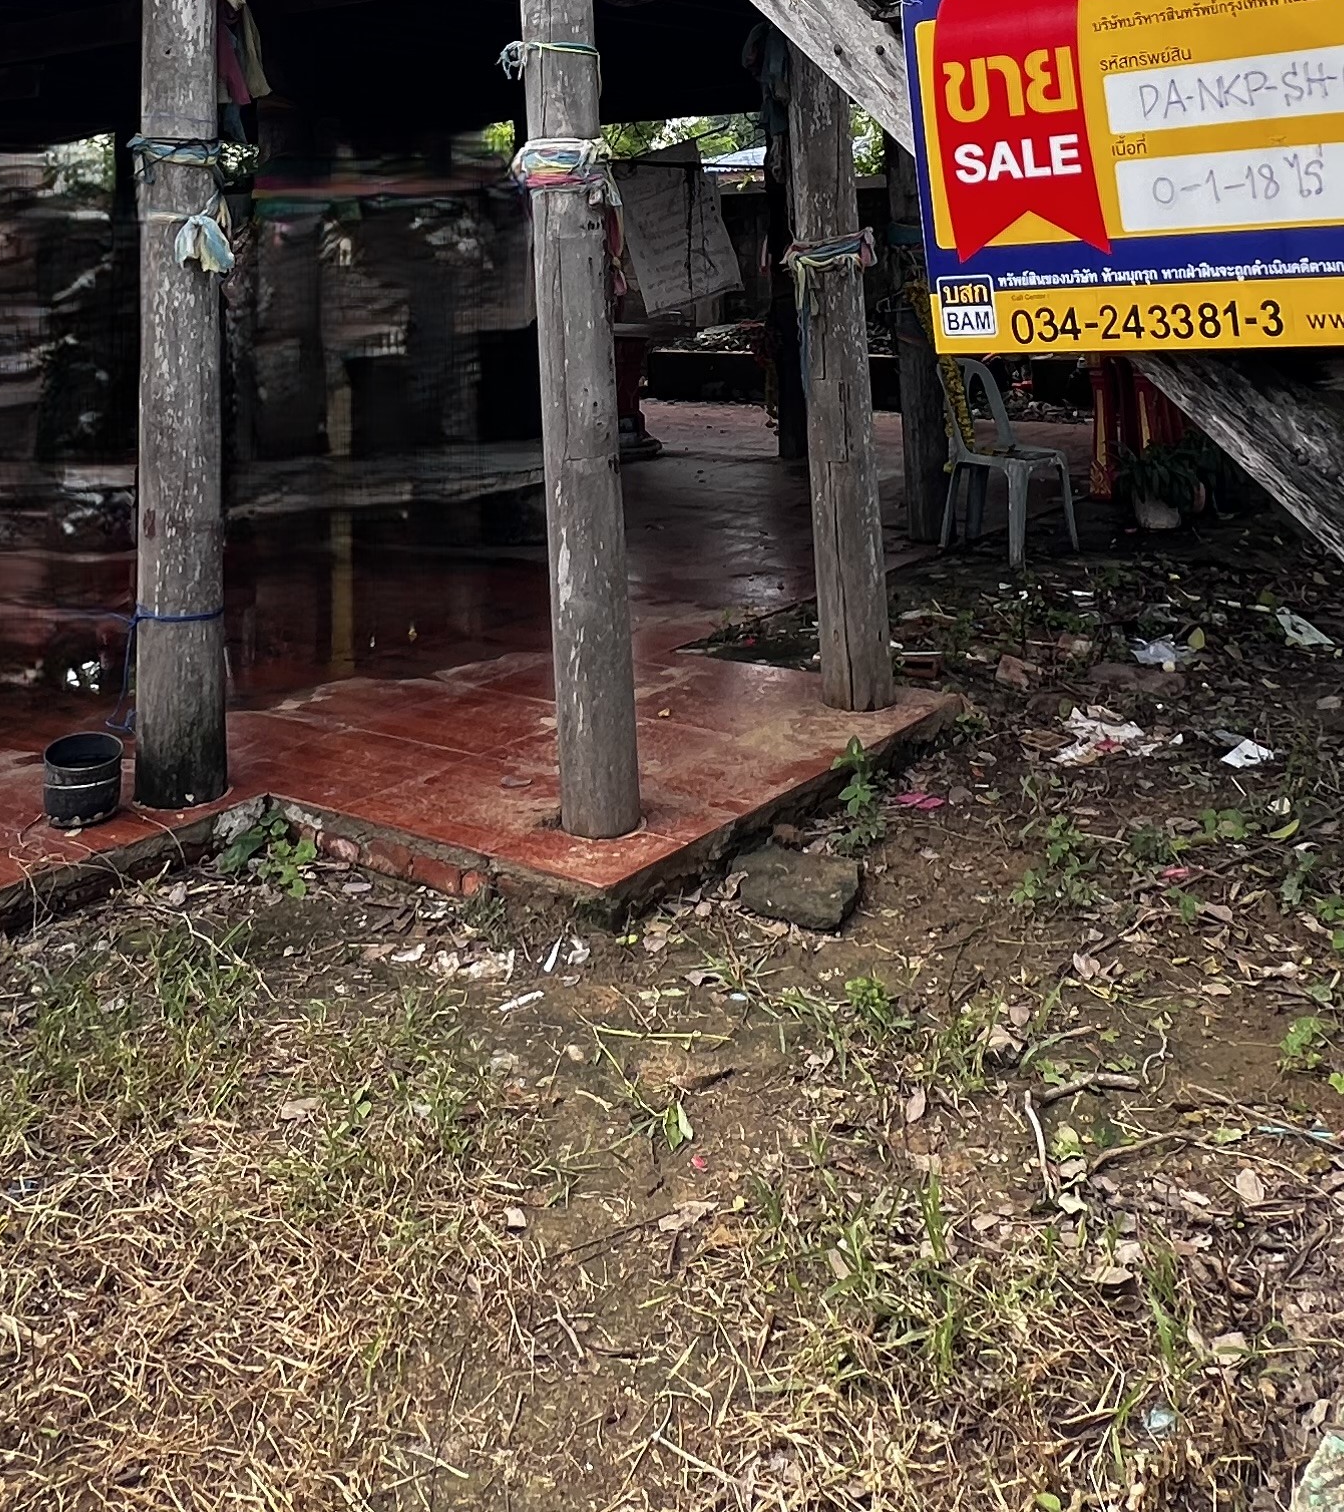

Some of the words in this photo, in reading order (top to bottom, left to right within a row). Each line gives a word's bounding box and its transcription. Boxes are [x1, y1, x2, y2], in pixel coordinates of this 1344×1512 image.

[1099, 45, 1193, 73] รหัสทรัพย์สิน
[942, 46, 1078, 123] ขาย
[954, 133, 1082, 184] SALE
[1112, 133, 1148, 158] เนื้อที่
[943, 281, 988, 304] บสก
[947, 310, 992, 332] BAM
[1010, 299, 1285, 345] 034-243381-3
